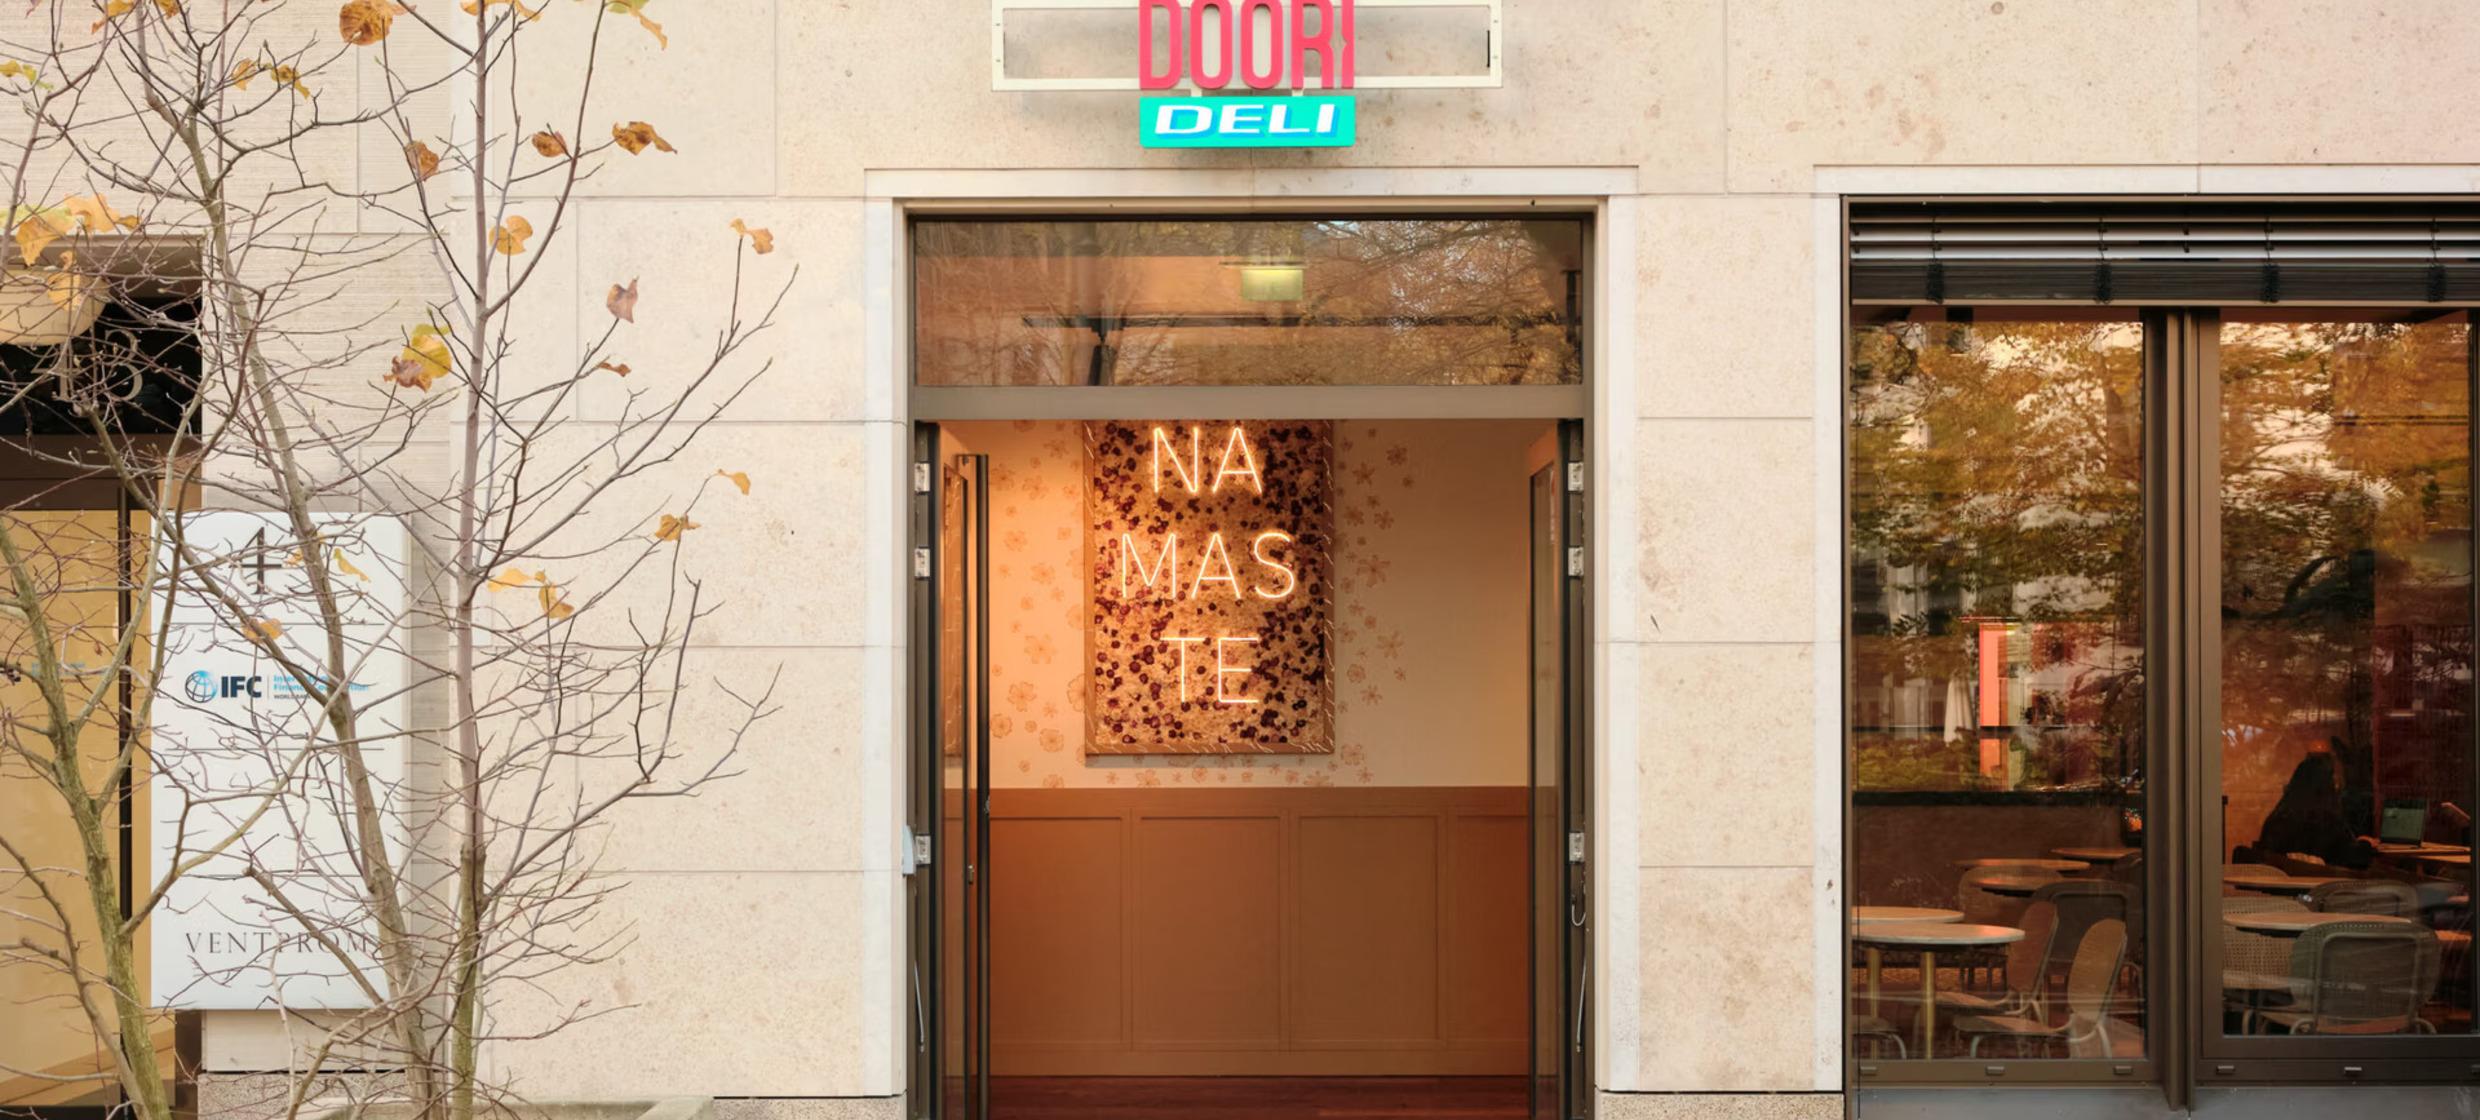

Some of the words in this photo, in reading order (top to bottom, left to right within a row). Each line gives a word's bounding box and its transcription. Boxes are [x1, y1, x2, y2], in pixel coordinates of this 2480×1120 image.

[1138, 0, 1355, 90] DOORI
[1155, 104, 1339, 138] DELI
[1153, 427, 1263, 494] NA
[1121, 532, 1295, 599] MAS
[221, 676, 262, 698] IFC
[1160, 635, 1260, 703] TE
